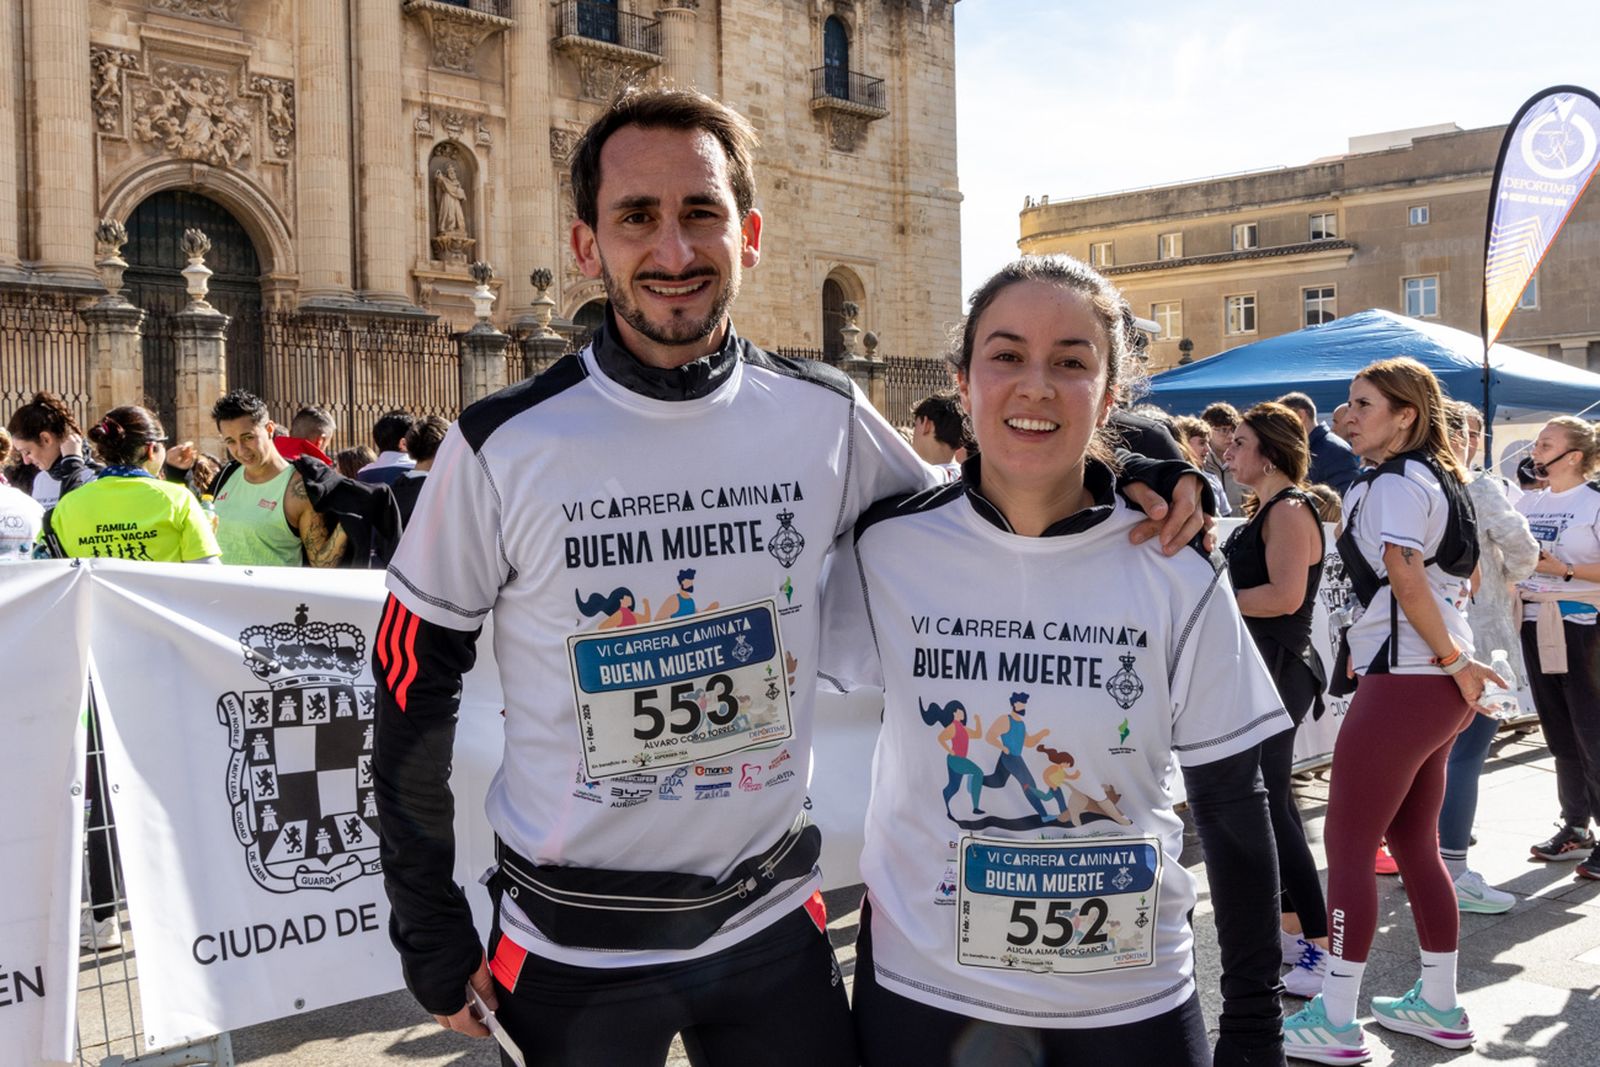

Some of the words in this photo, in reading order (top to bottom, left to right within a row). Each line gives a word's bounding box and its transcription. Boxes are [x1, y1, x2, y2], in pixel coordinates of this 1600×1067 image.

[562, 502, 584, 522] VI
[591, 490, 695, 519] CARRERA
[701, 481, 804, 510] CAMINATA
[96, 522, 138, 533] FAMILIA
[122, 529, 158, 542] VACAS
[565, 530, 653, 569] BUENA
[662, 520, 765, 561] MUERTE
[597, 644, 611, 657] VI
[614, 633, 679, 655] CARRERA
[683, 616, 752, 644] CAMINATA
[911, 615, 930, 635] VI
[936, 617, 1036, 640] CARRERA
[1043, 621, 1148, 648] CAMINATA
[600, 660, 656, 686] BUENA
[659, 645, 725, 677] MUERTE
[913, 647, 988, 681] BUENA
[998, 651, 1103, 689] MUERTE
[226, 699, 237, 716] MUY
[232, 717, 240, 744] NOBLE
[633, 674, 739, 741] 553
[644, 738, 678, 749] ÁLVARO
[708, 724, 735, 737] TORRES
[231, 763, 239, 780] MUY
[236, 811, 248, 839] CIUDAD
[249, 851, 257, 863] DE
[987, 851, 1000, 863] VI
[1003, 853, 1066, 866] CARRERA
[1069, 850, 1137, 866] CAMINATA
[301, 874, 336, 886] GUARDA
[335, 872, 343, 881] Y
[985, 869, 1037, 892] BUENA
[1042, 872, 1105, 892] MUERTE
[192, 914, 327, 966] CIUDAD
[335, 902, 380, 937] DE
[1006, 897, 1109, 947] 552
[1006, 946, 1033, 955] ALICIA
[1035, 947, 1076, 956] ALMAGRO
